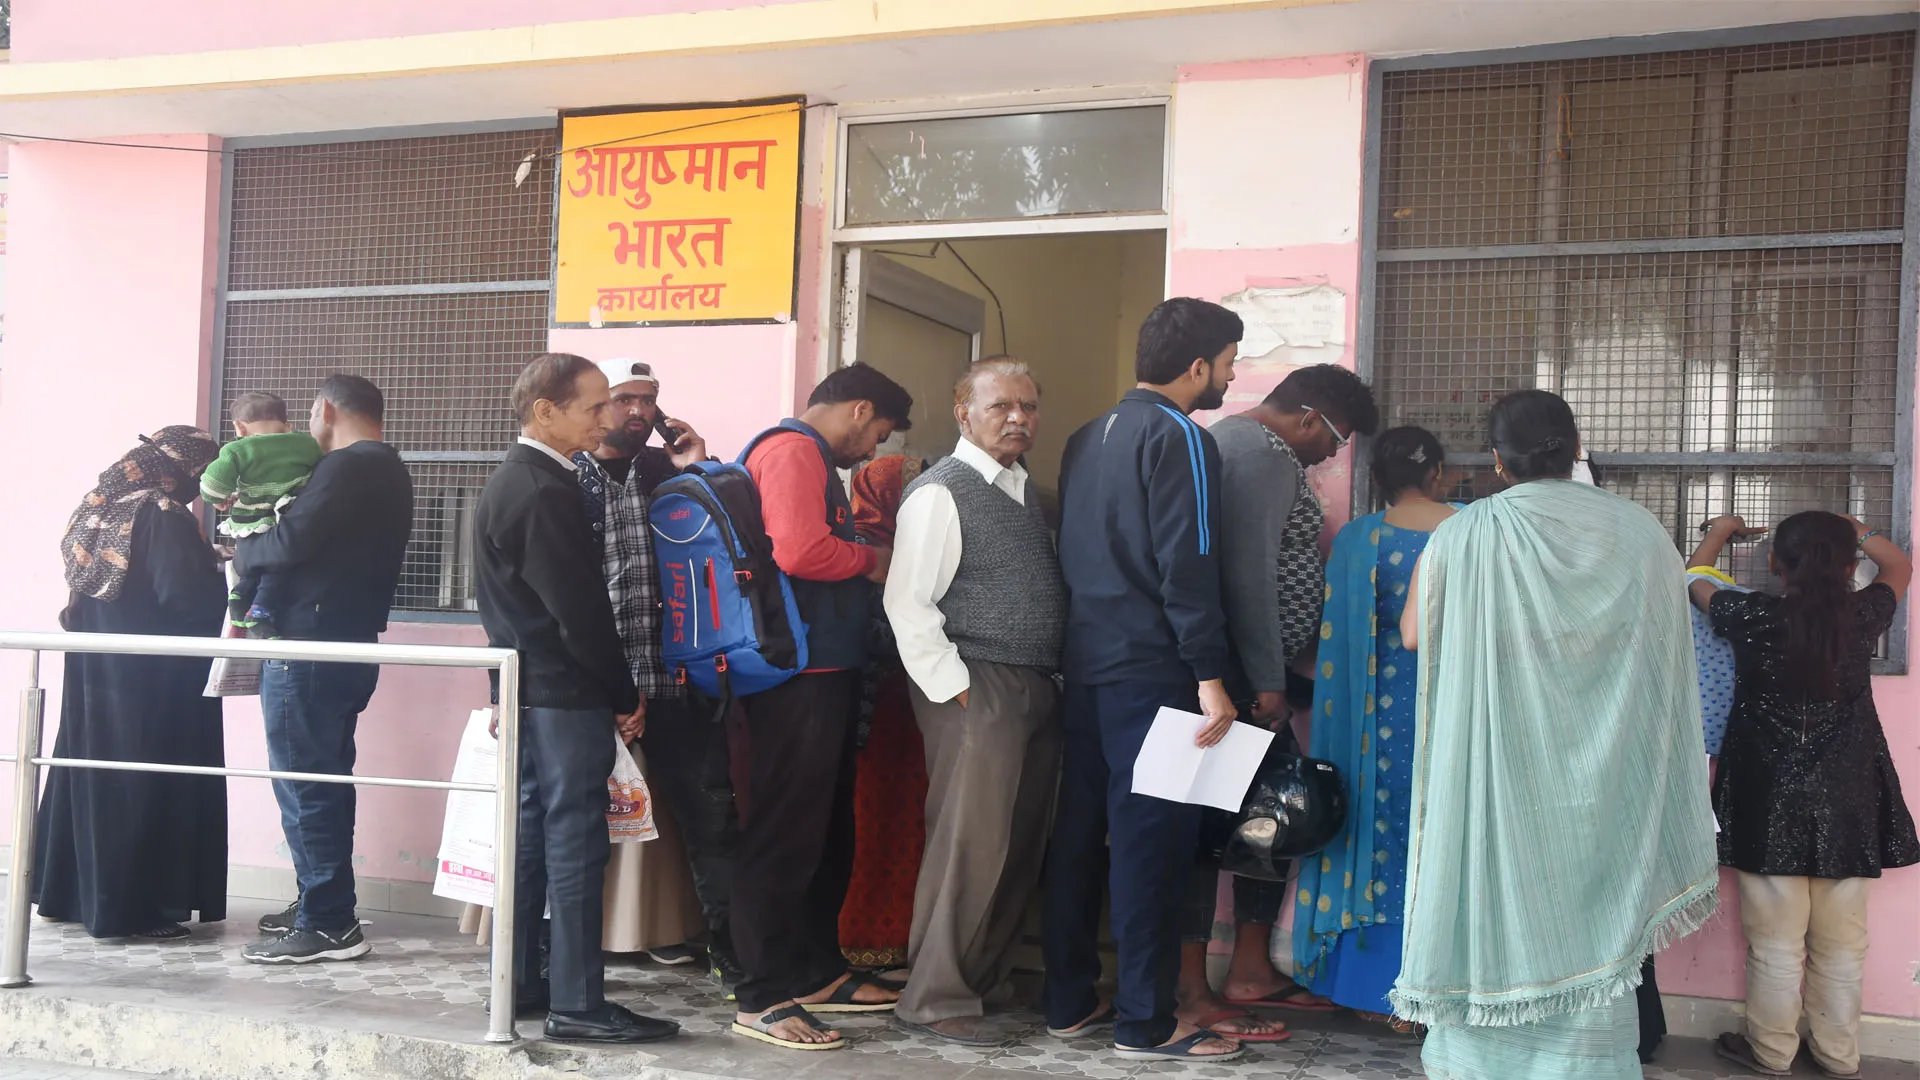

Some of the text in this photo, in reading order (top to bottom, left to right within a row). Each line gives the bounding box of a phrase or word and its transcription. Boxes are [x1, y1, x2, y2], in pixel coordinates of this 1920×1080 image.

[567, 139, 778, 210] आयुष्मान
[607, 217, 733, 269] भारत
[597, 273, 727, 312] कार्यालय
[665, 562, 687, 643] safari
